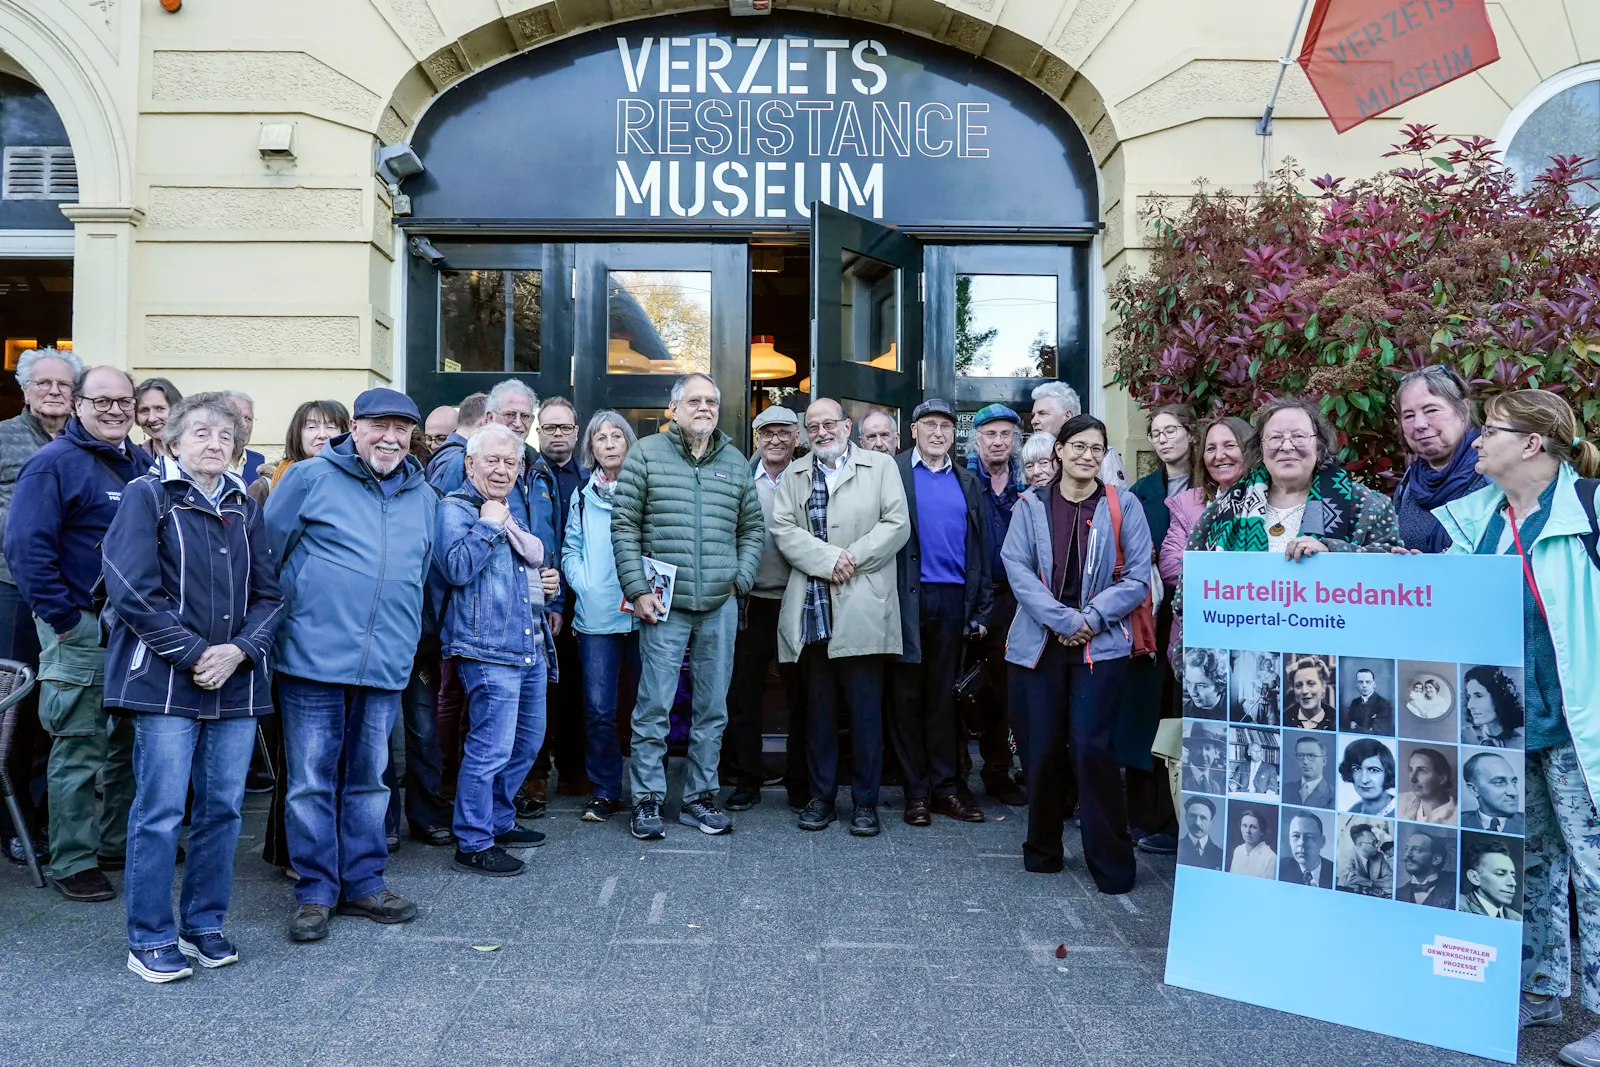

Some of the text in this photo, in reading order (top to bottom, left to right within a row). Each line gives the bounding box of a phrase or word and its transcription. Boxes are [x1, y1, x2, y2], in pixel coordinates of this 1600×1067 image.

[616, 37, 887, 96] VERZETS
[1355, 43, 1473, 119] MUSEUM
[615, 98, 990, 158] RESISTANCE
[615, 160, 884, 219] MUSEUM
[956, 414, 975, 422] VERZ
[956, 429, 973, 437] MUS
[1203, 579, 1433, 608] Hartelijk bedankt!
[1203, 610, 1346, 629] Wuppertal-Comitè
[1427, 948, 1486, 964] GEWERKSCHAFTS
[1442, 943, 1491, 958] WUPPERTALER
[1443, 960, 1478, 971] PROZESSE
